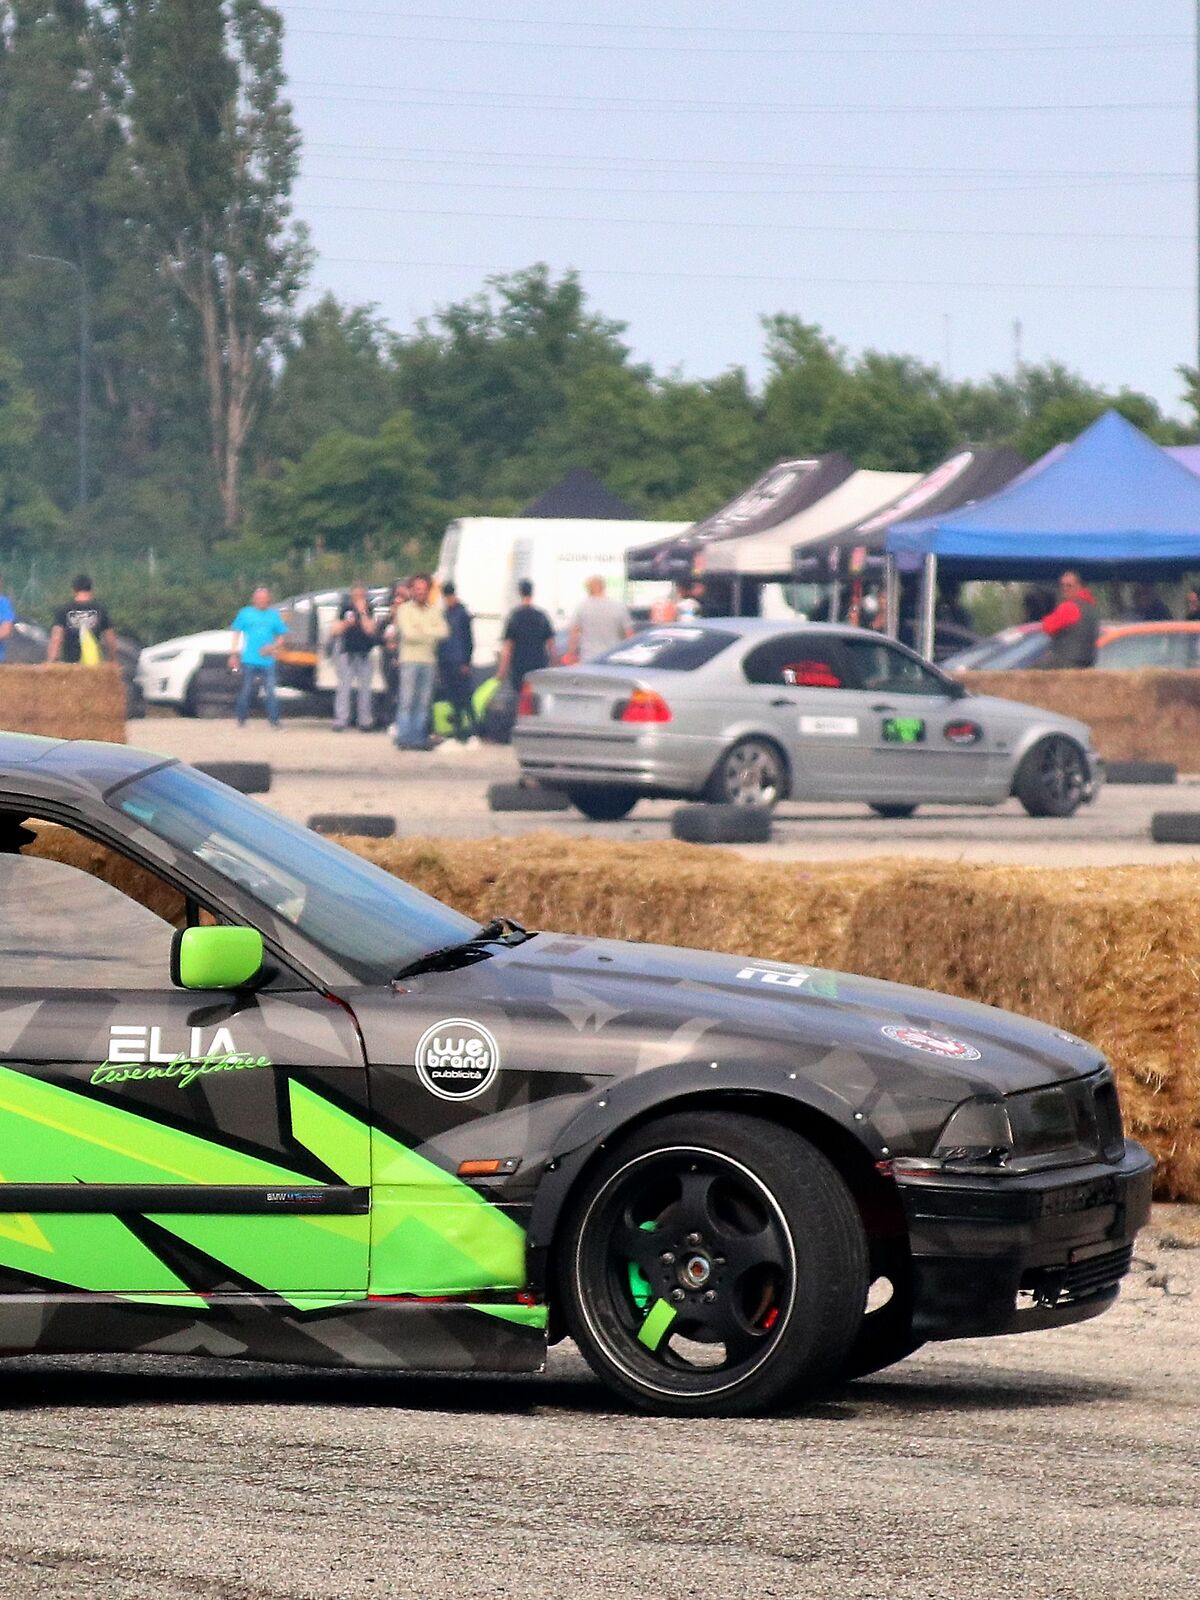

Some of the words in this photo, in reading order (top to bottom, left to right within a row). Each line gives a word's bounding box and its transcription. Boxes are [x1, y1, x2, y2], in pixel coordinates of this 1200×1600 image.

[108, 1026, 238, 1063] ELIA
[433, 1037, 484, 1057] we
[427, 1049, 490, 1069] brand
[90, 1052, 271, 1089] twentythree
[266, 1193, 287, 1201] BMW
